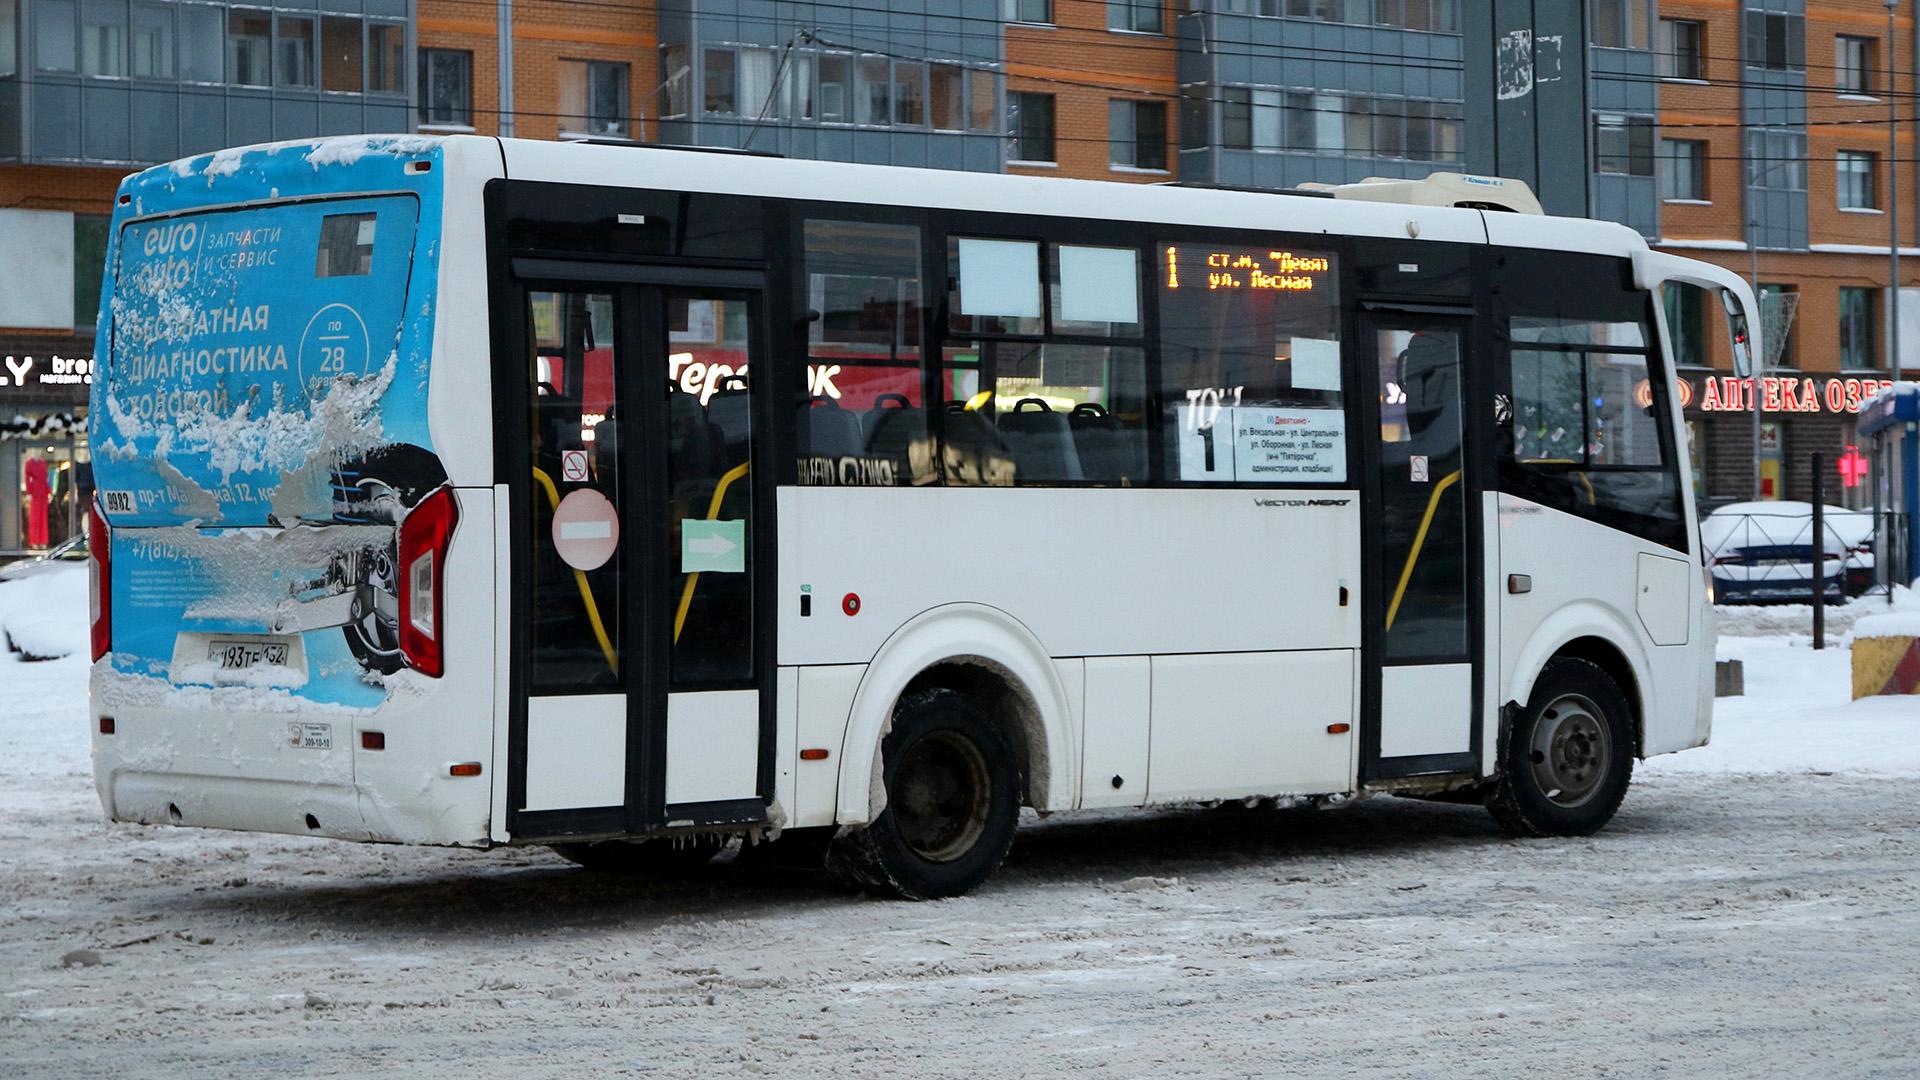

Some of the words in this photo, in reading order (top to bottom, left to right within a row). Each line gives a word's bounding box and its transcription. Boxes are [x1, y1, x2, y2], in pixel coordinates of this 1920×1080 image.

[144, 222, 197, 256] euro
[207, 227, 281, 249] ЗАПЧАСТИ
[219, 250, 277, 270] СЕРВИС
[1167, 246, 1179, 288] 1
[1250, 270, 1313, 289] Лесная
[129, 344, 288, 385] ДИАГНОСТИКА
[320, 346, 346, 372] 28
[1701, 376, 1820, 412] АПТЕКА
[1197, 426, 1215, 472] 1
[107, 490, 132, 513] 9982
[138, 484, 165, 508] пр-т
[1254, 498, 1305, 507] VECTOR
[1306, 499, 1351, 507] NEXT
[210, 645, 262, 668] 193ТЕ
